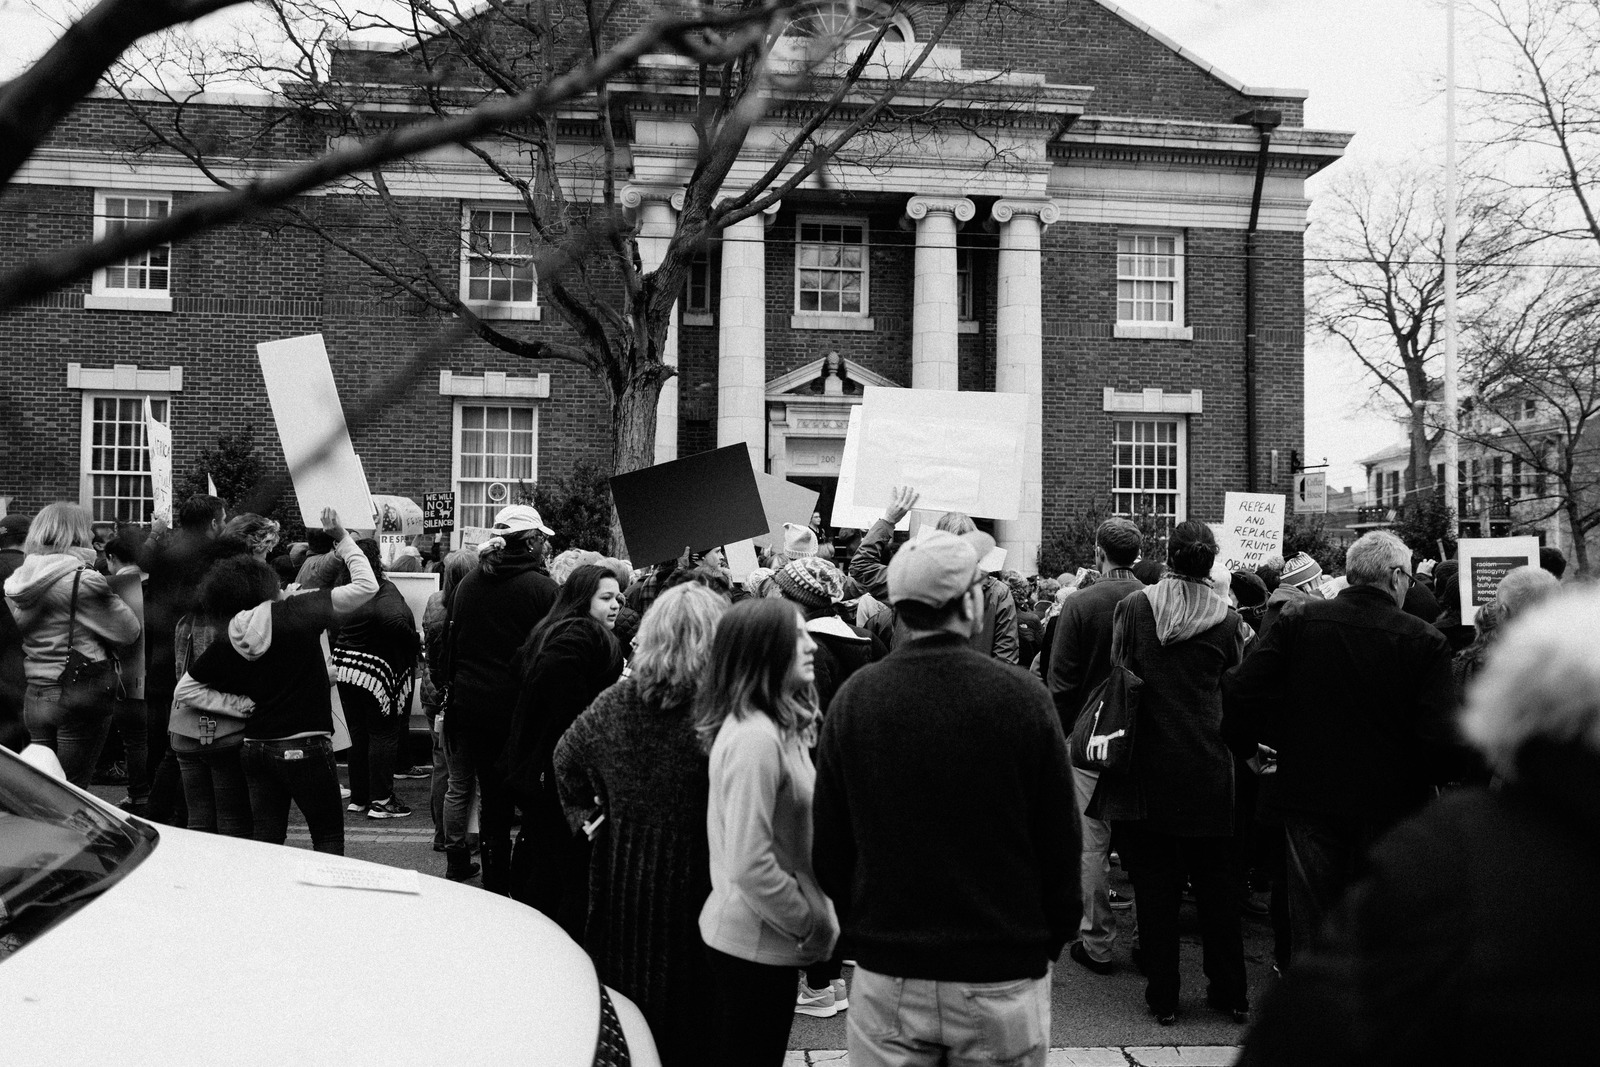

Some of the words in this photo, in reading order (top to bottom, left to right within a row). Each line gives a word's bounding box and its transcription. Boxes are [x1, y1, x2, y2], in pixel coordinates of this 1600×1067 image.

[427, 500, 452, 510] NOT
[1239, 500, 1277, 514] REPEAL
[424, 510, 435, 518] BE
[424, 519, 454, 528] SILENCED
[1245, 516, 1265, 526] AND
[1234, 526, 1279, 539] REPLACE
[381, 535, 405, 544] RESP
[1240, 539, 1277, 552] TRUMP
[1244, 551, 1265, 561] NOT
[1225, 558, 1260, 573] OBAM
